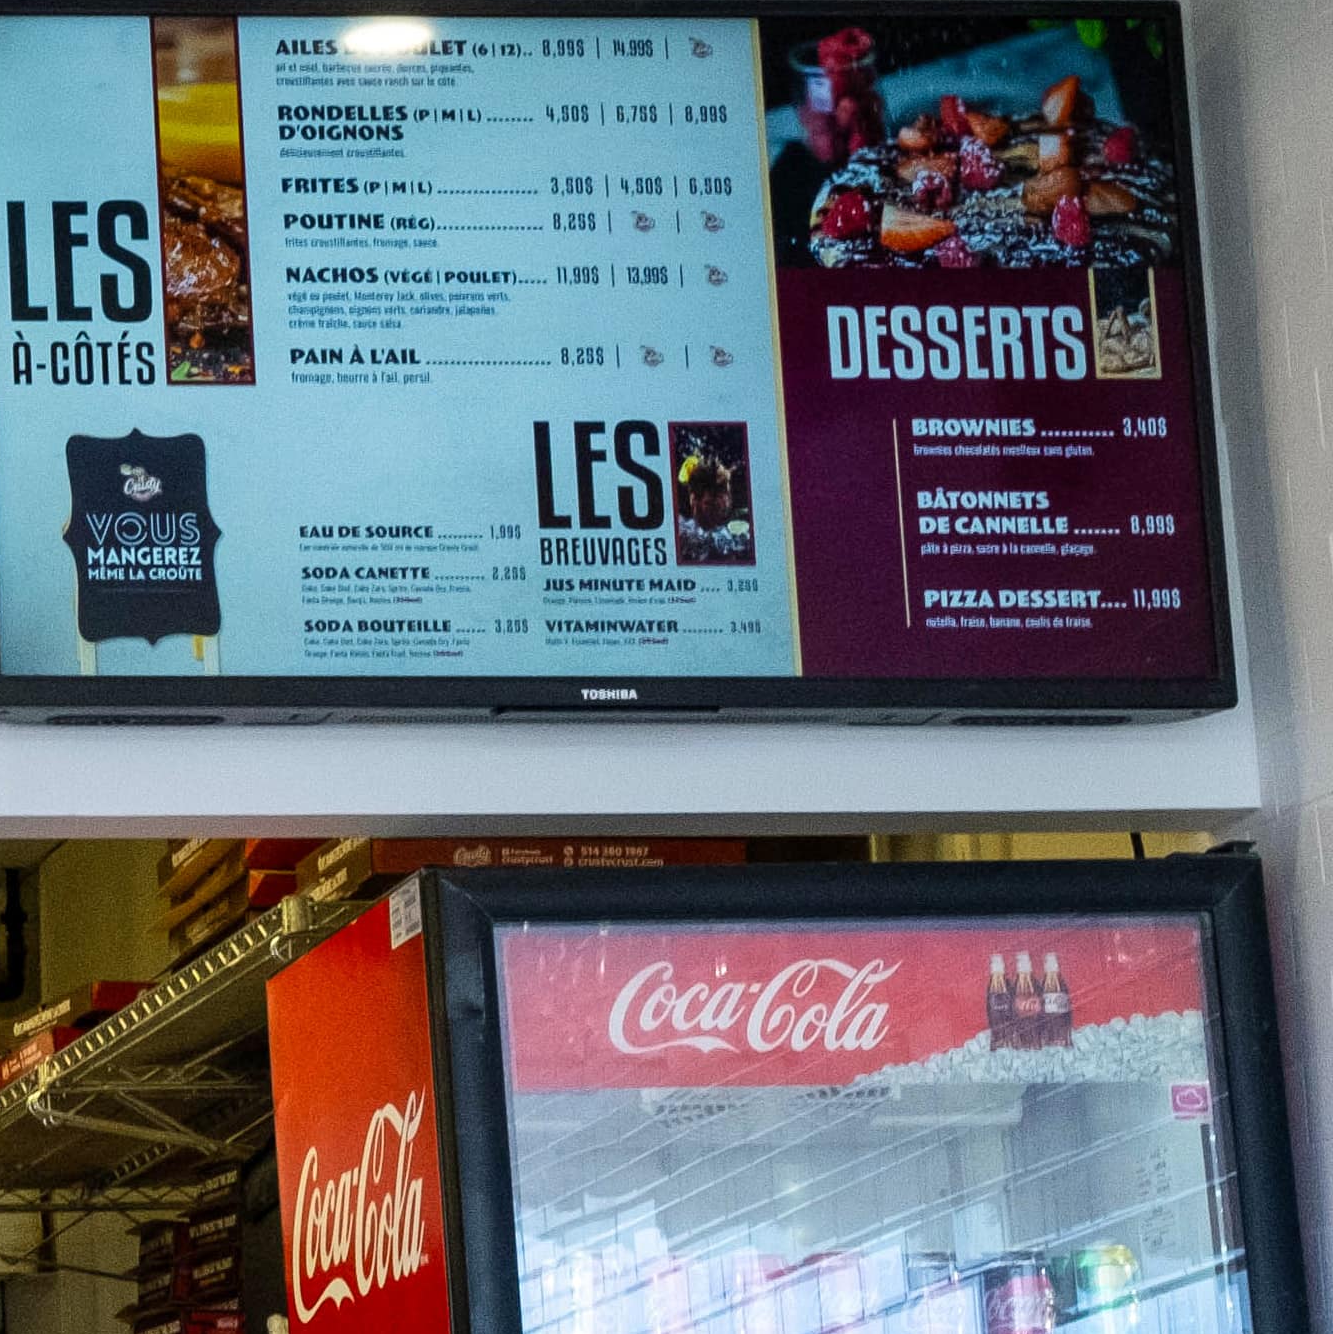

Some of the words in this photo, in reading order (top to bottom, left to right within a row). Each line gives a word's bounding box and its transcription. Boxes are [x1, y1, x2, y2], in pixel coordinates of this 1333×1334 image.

[276, 39, 337, 56] AILES
[278, 105, 408, 121] RONDELLES
[279, 125, 403, 140] D'OIGNONS
[282, 178, 359, 194] FRITES
[284, 214, 384, 229] POUTINE
[6, 200, 153, 322] LES
[286, 267, 378, 283] NACHOS
[827, 305, 1087, 380] DESSERTS
[13, 331, 155, 385] À-CÔTÉS
[290, 349, 343, 364] PAIN
[349, 344, 365, 364] À
[370, 349, 420, 364] L'AIL
[912, 419, 1035, 436] BROWNIES
[533, 420, 665, 531] LES
[917, 488, 1049, 509] BÂTONNETS
[85, 511, 201, 546] VOUS
[299, 525, 334, 539] EAU
[339, 525, 361, 539] DE
[365, 525, 433, 539] SOURCE
[919, 518, 949, 534] DE
[955, 518, 1068, 534] CANNELLE
[87, 547, 202, 566] MANGEREZ
[539, 536, 667, 567] BREUVAGES
[88, 567, 127, 580] MÊME
[130, 567, 146, 580] LA
[149, 567, 202, 580] CROÛTE
[301, 567, 351, 580] SODA
[355, 567, 430, 580] CANETTE
[543, 579, 575, 593] JUS
[579, 579, 645, 593] MINUTE
[651, 579, 696, 593] MAID
[924, 590, 993, 608] PIZZA
[304, 619, 353, 633] SODA
[357, 619, 451, 633] BOUTEILLE
[545, 619, 678, 634] VITAMINWATER
[582, 689, 637, 701] TOSHIBA
[607, 958, 902, 1055] Coca-Cola
[293, 1083, 426, 1324] Coca-Cola
